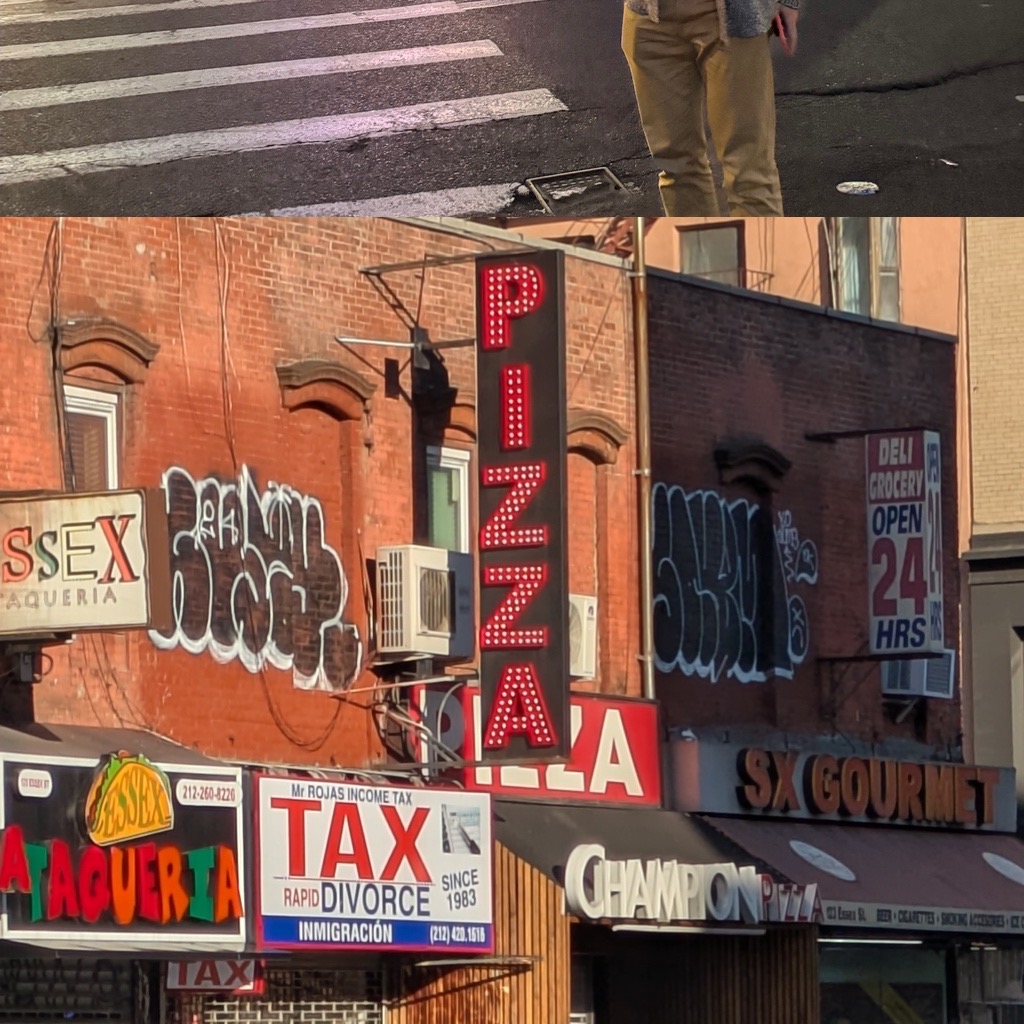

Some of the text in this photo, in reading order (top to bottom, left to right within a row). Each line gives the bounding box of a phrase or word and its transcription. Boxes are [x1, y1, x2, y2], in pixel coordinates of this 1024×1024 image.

[878, 437, 914, 466] DELI
[869, 469, 924, 500] GROCERY
[478, 262, 556, 750] PIZZA
[872, 503, 923, 536] OPEN
[872, 537, 928, 617] 24
[876, 618, 927, 650] HRS
[98, 765, 167, 839] ESSEX
[291, 783, 413, 806] Mr ROJAS INCOME TAX
[738, 746, 1000, 827] SX GOURMET
[270, 796, 433, 884] TAX
[23, 838, 244, 925] TAQUERIA
[442, 869, 479, 892] SINCE
[564, 843, 826, 923] CHAMPION PIZZA
[283, 882, 431, 917] RAPID DIVORCE
[446, 888, 477, 911] 1983
[298, 919, 393, 944] INMIGRACIÓN
[429, 925, 450, 945] (212)
[876, 908, 893, 923] BEER
[897, 910, 936, 925] CIGARETTES
[175, 959, 252, 987] TAX
